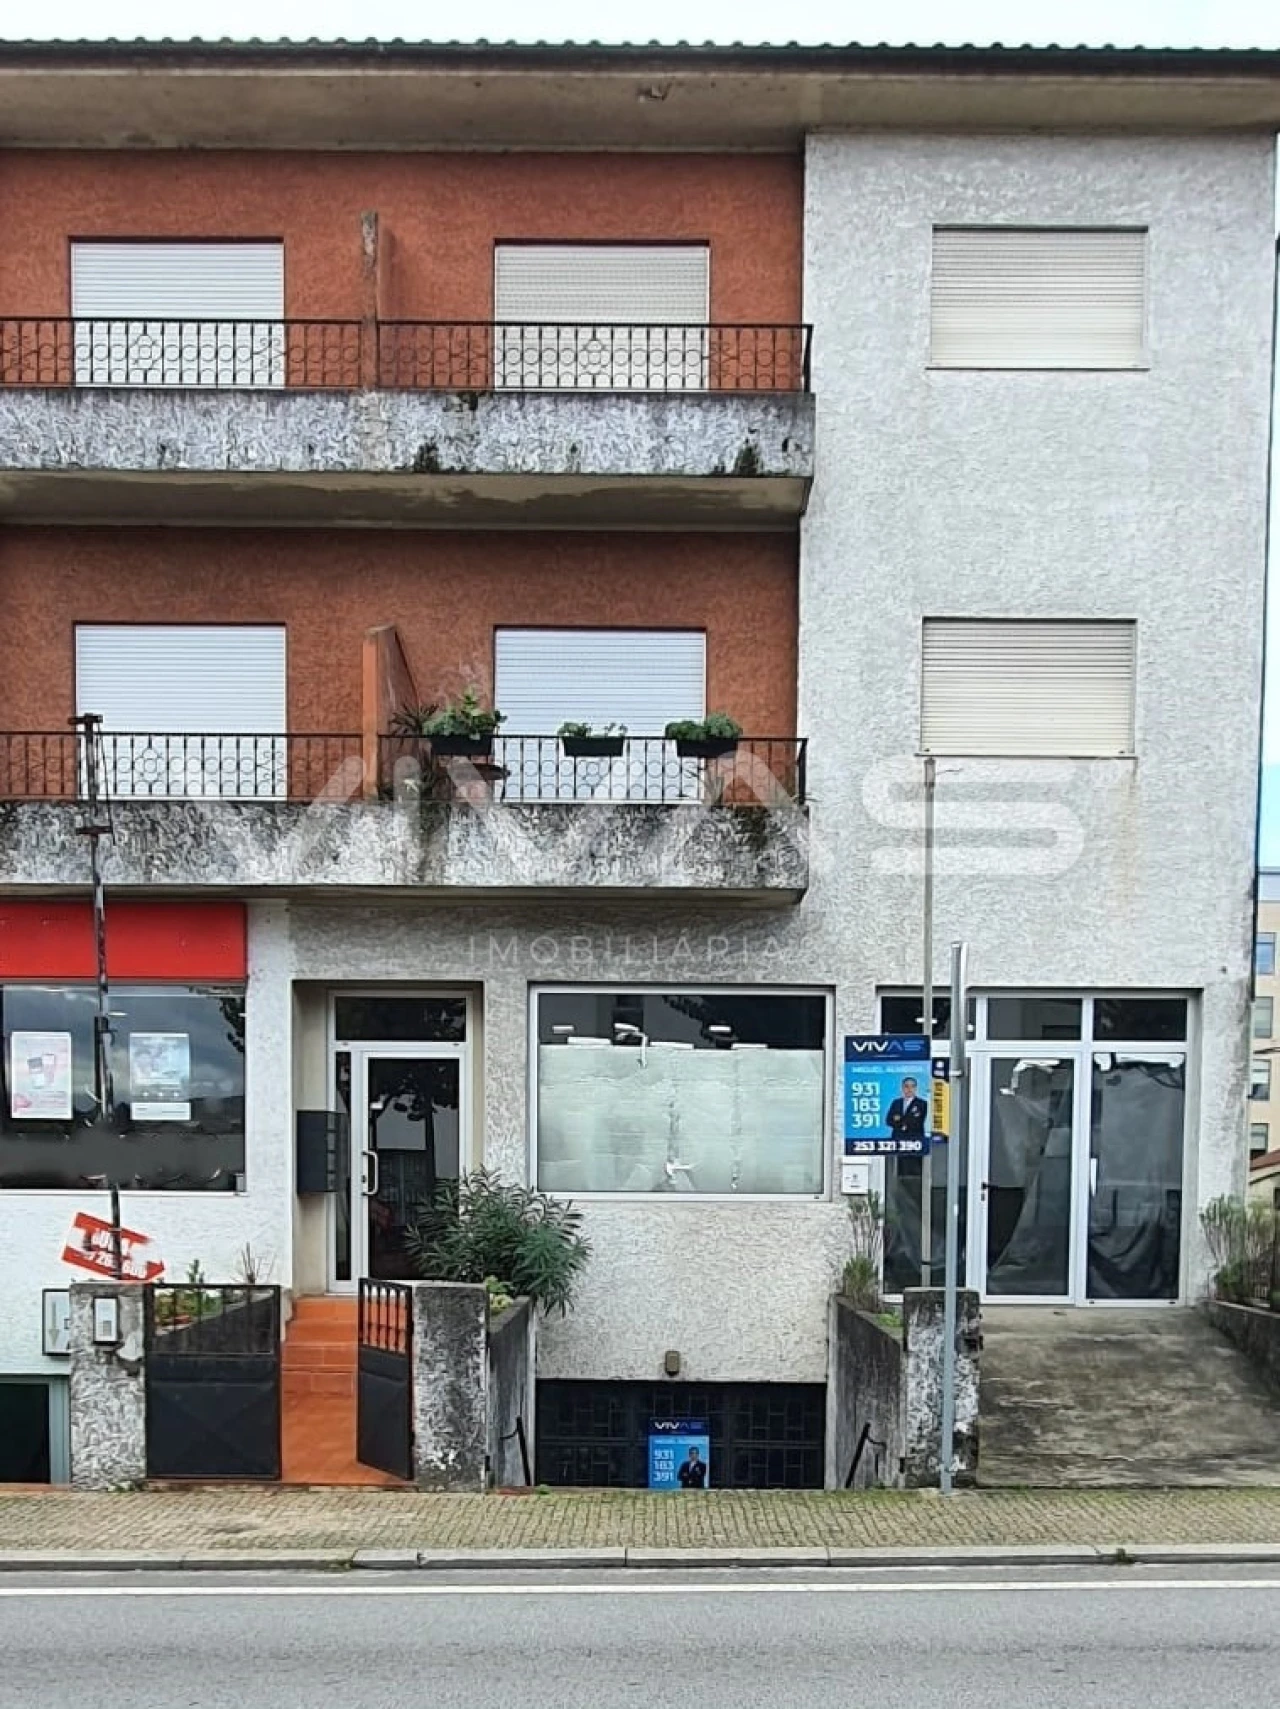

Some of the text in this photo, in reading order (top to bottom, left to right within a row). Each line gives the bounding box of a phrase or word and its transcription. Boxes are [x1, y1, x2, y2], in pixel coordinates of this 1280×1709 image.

[852, 1040, 924, 1053] VIVAS
[852, 1082, 880, 1096] 931
[852, 1098, 880, 1112] 183
[852, 1114, 880, 1128] 391
[853, 1141, 875, 1151] 253
[654, 1421, 704, 1430] VIVAS
[653, 1448, 675, 1460] 931
[653, 1471, 675, 1482] 391
